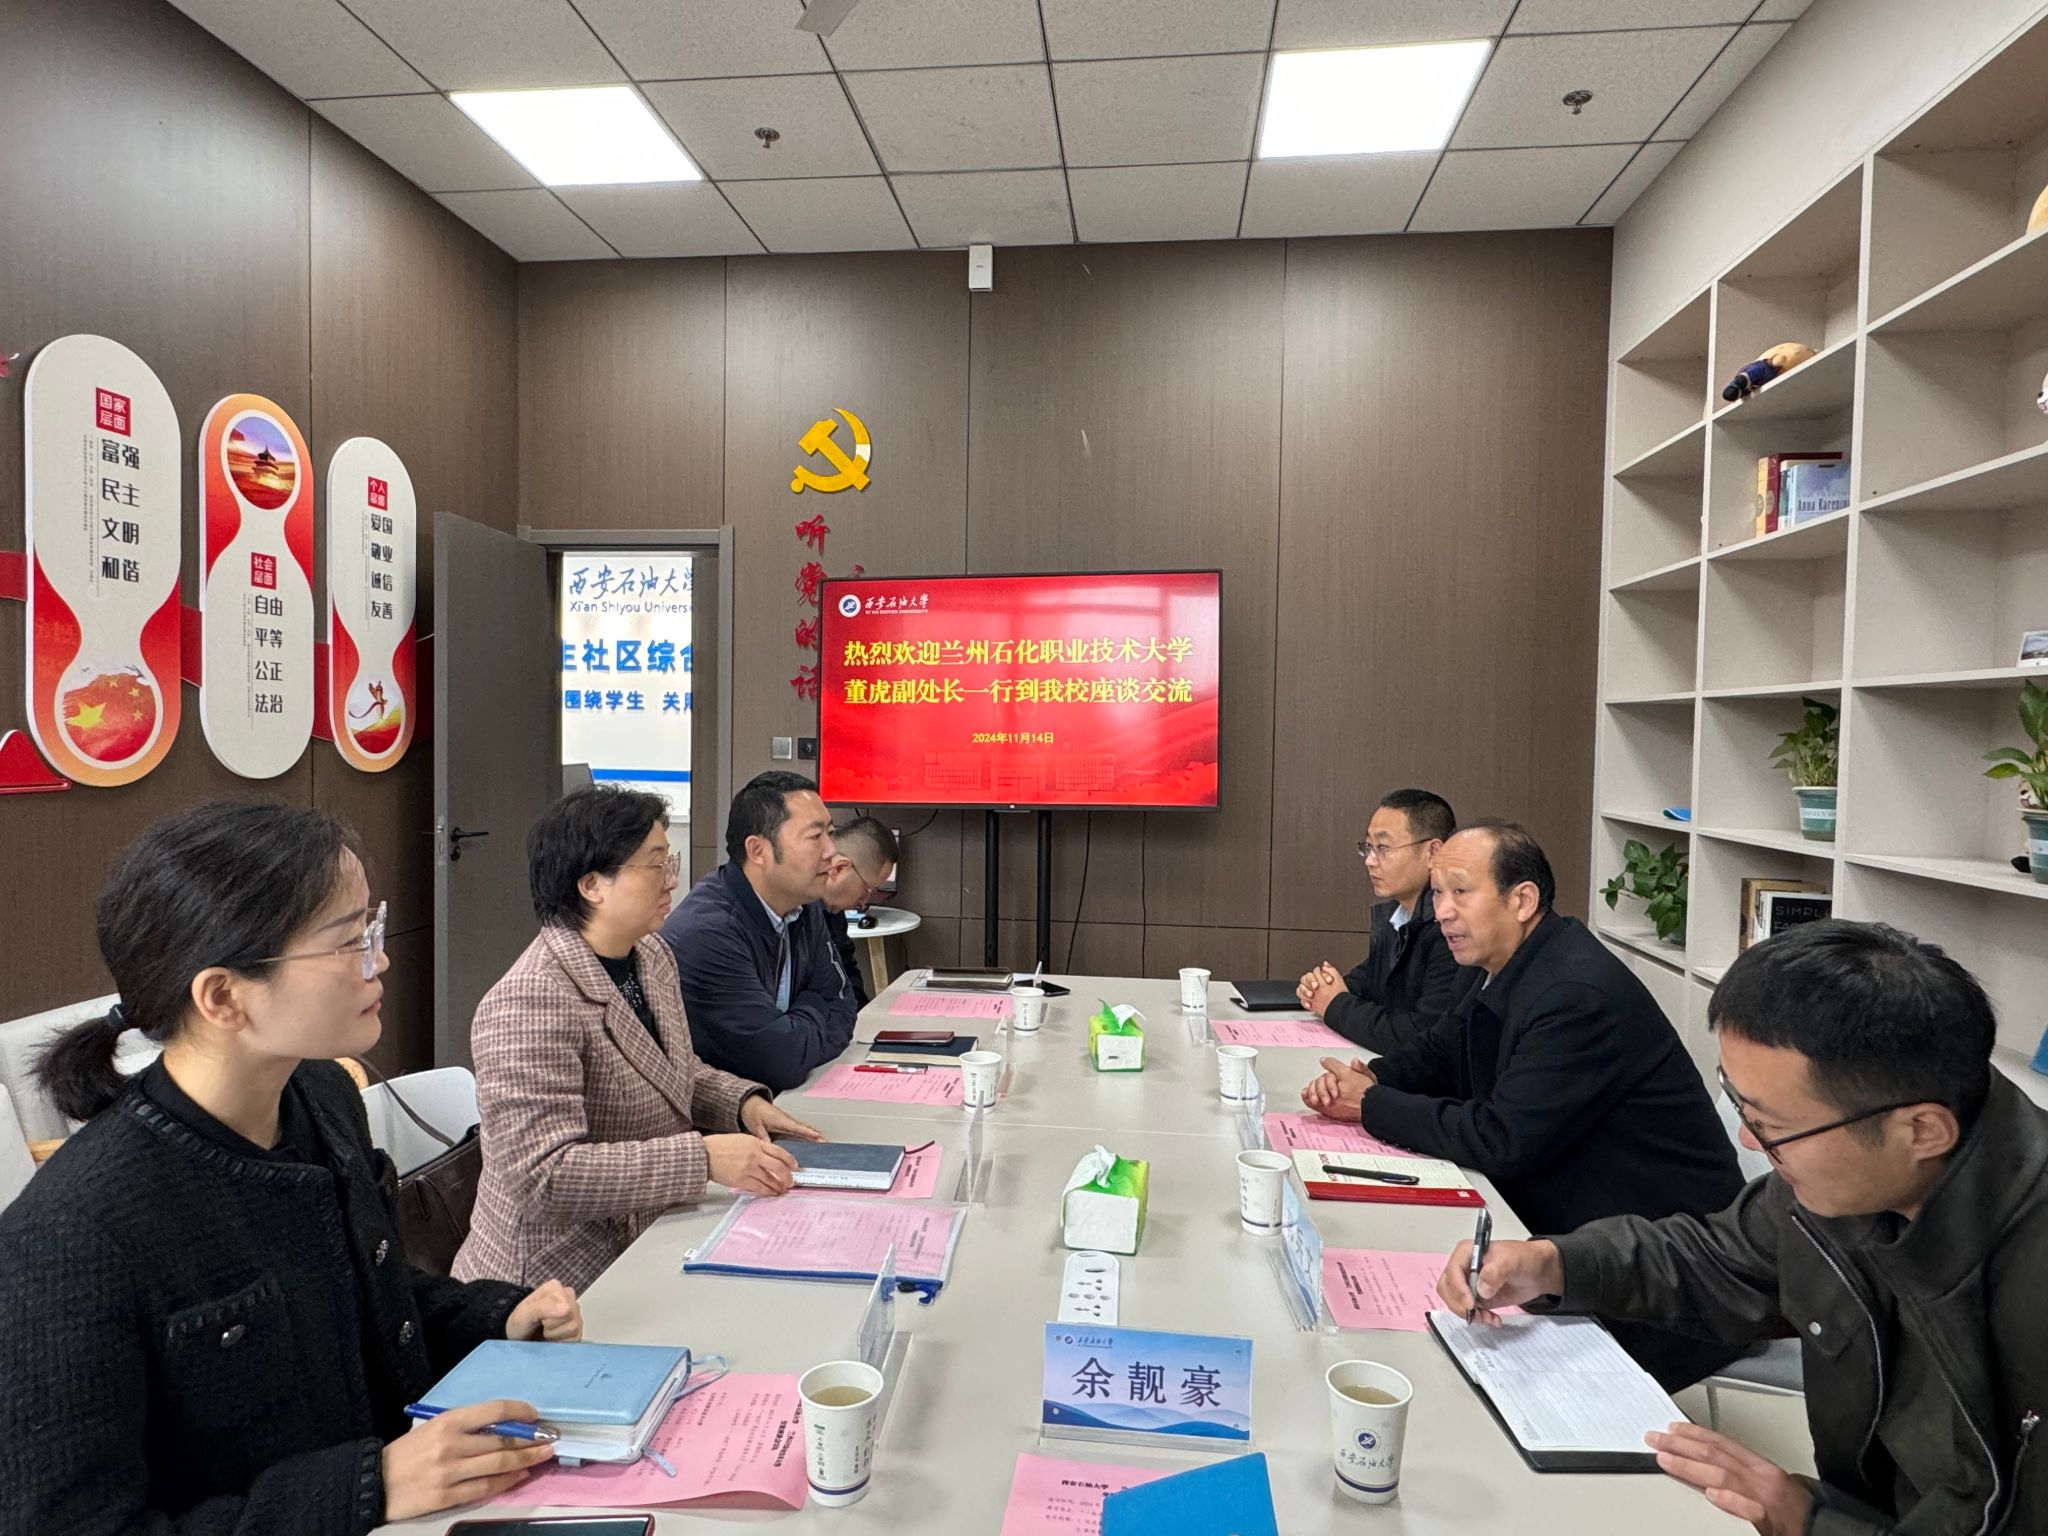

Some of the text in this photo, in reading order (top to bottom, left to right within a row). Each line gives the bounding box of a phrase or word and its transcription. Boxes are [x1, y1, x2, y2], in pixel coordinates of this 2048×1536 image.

[99, 392, 127, 415] 国家
[99, 410, 127, 431] 层面
[101, 438, 141, 471] 富强
[101, 477, 141, 509] 民主
[369, 479, 386, 494] 个人
[369, 492, 386, 507] 层面
[101, 517, 141, 546] 文明
[370, 513, 393, 535] 爱国
[253, 555, 273, 571] 社会
[370, 542, 393, 564] 敬业
[101, 555, 141, 584] 和谐
[253, 571, 273, 586] 层面
[370, 571, 393, 592] 诚信
[254, 594, 283, 617] 自由
[370, 600, 393, 621] 友善
[569, 601, 598, 613] Xi'an
[601, 601, 641, 616] Shiyou
[254, 627, 283, 650] 平等
[843, 636, 1195, 667] 热烈欢迎兰州石化职业技术大学
[254, 660, 283, 682] 公正
[565, 689, 645, 711] 围绕学生
[843, 677, 1194, 705] 董虎副处长一行到我校座谈交流
[254, 693, 283, 714] 法治
[971, 731, 1055, 745] 2024年11月14日
[1071, 1356, 1222, 1408] 余靓豪
